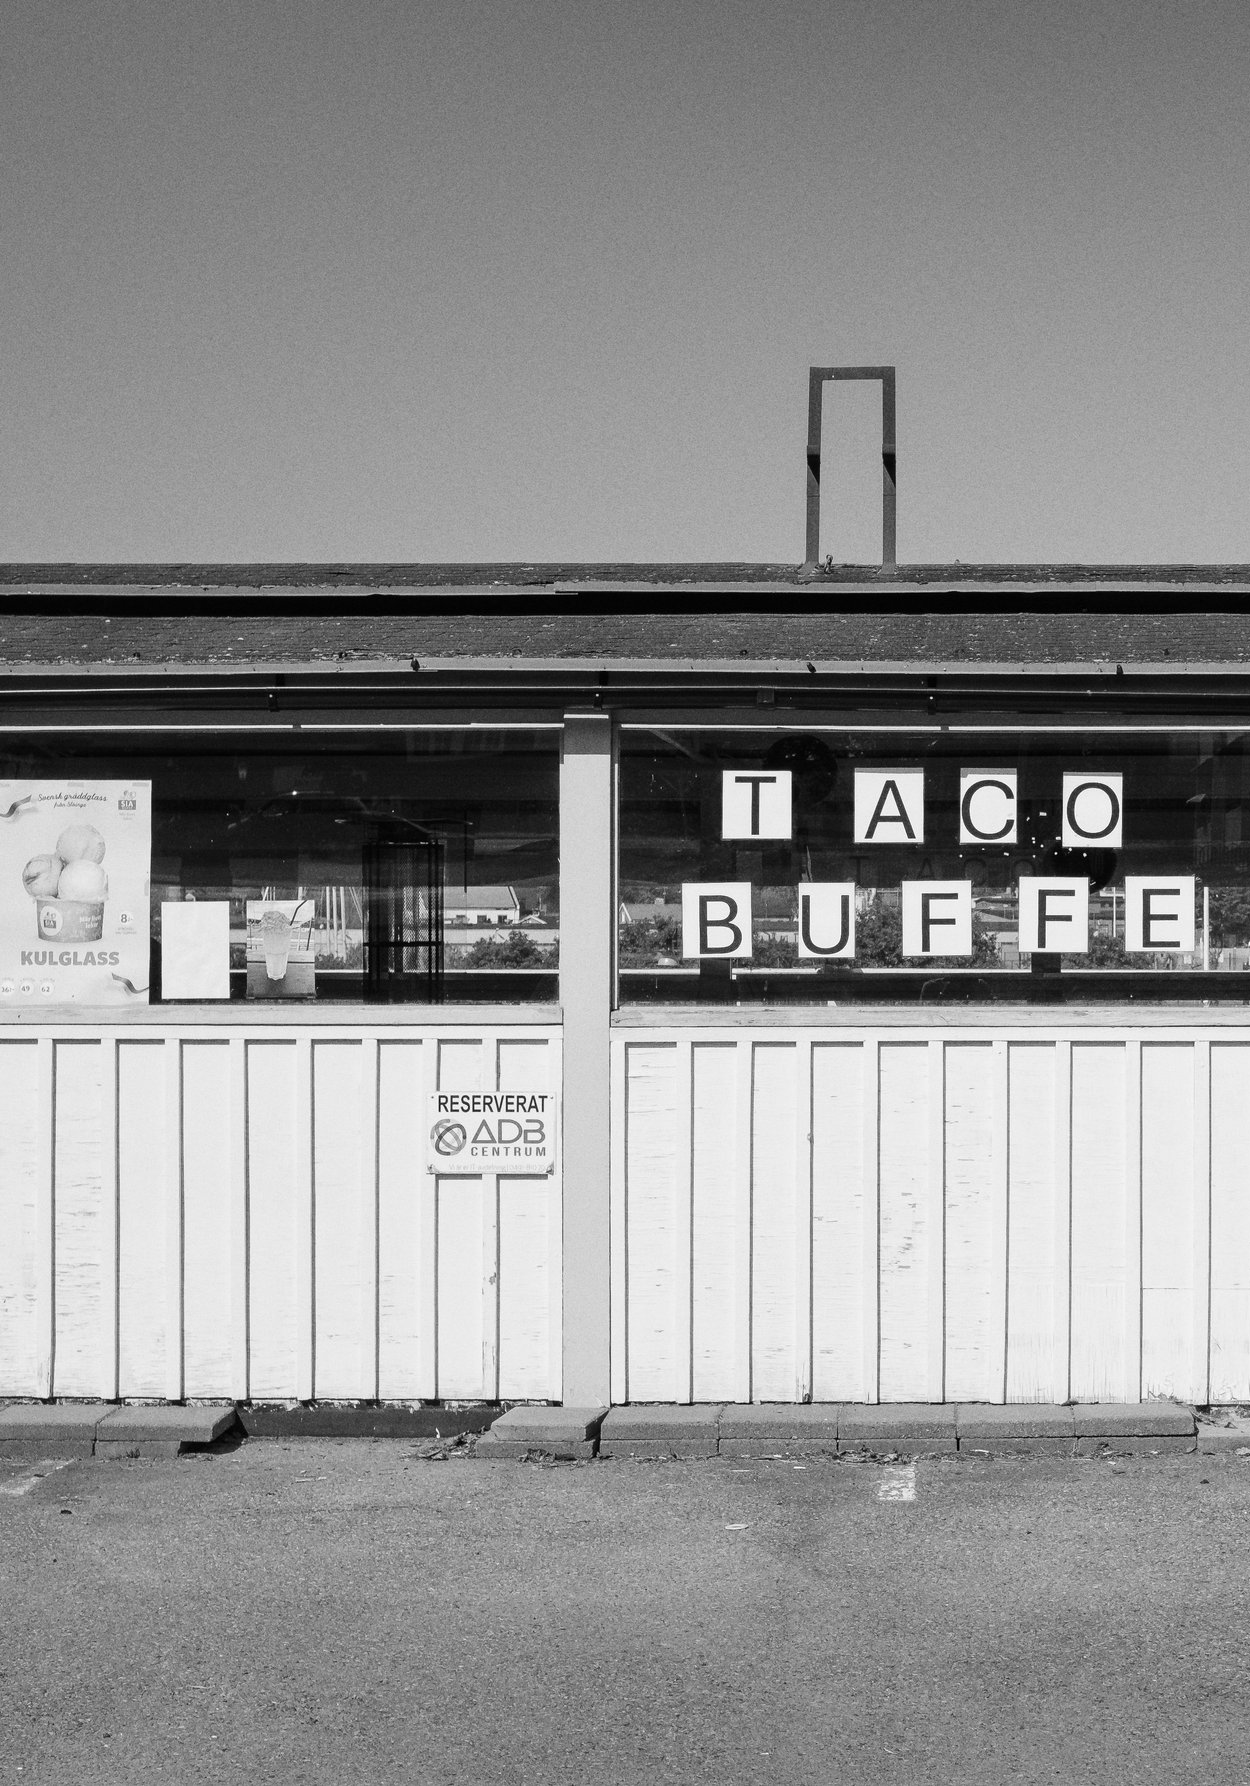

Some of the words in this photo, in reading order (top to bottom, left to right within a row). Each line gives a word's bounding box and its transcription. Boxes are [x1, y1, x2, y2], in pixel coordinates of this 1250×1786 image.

[38, 792, 63, 802] Svensk
[734, 775, 1121, 841] TACO
[698, 887, 1182, 955] BUFFE
[21, 951, 120, 966] KULGLASS
[438, 1095, 548, 1113] RESERVERAT
[470, 1118, 546, 1144] ADB
[470, 1146, 546, 1157] CENTRUM
